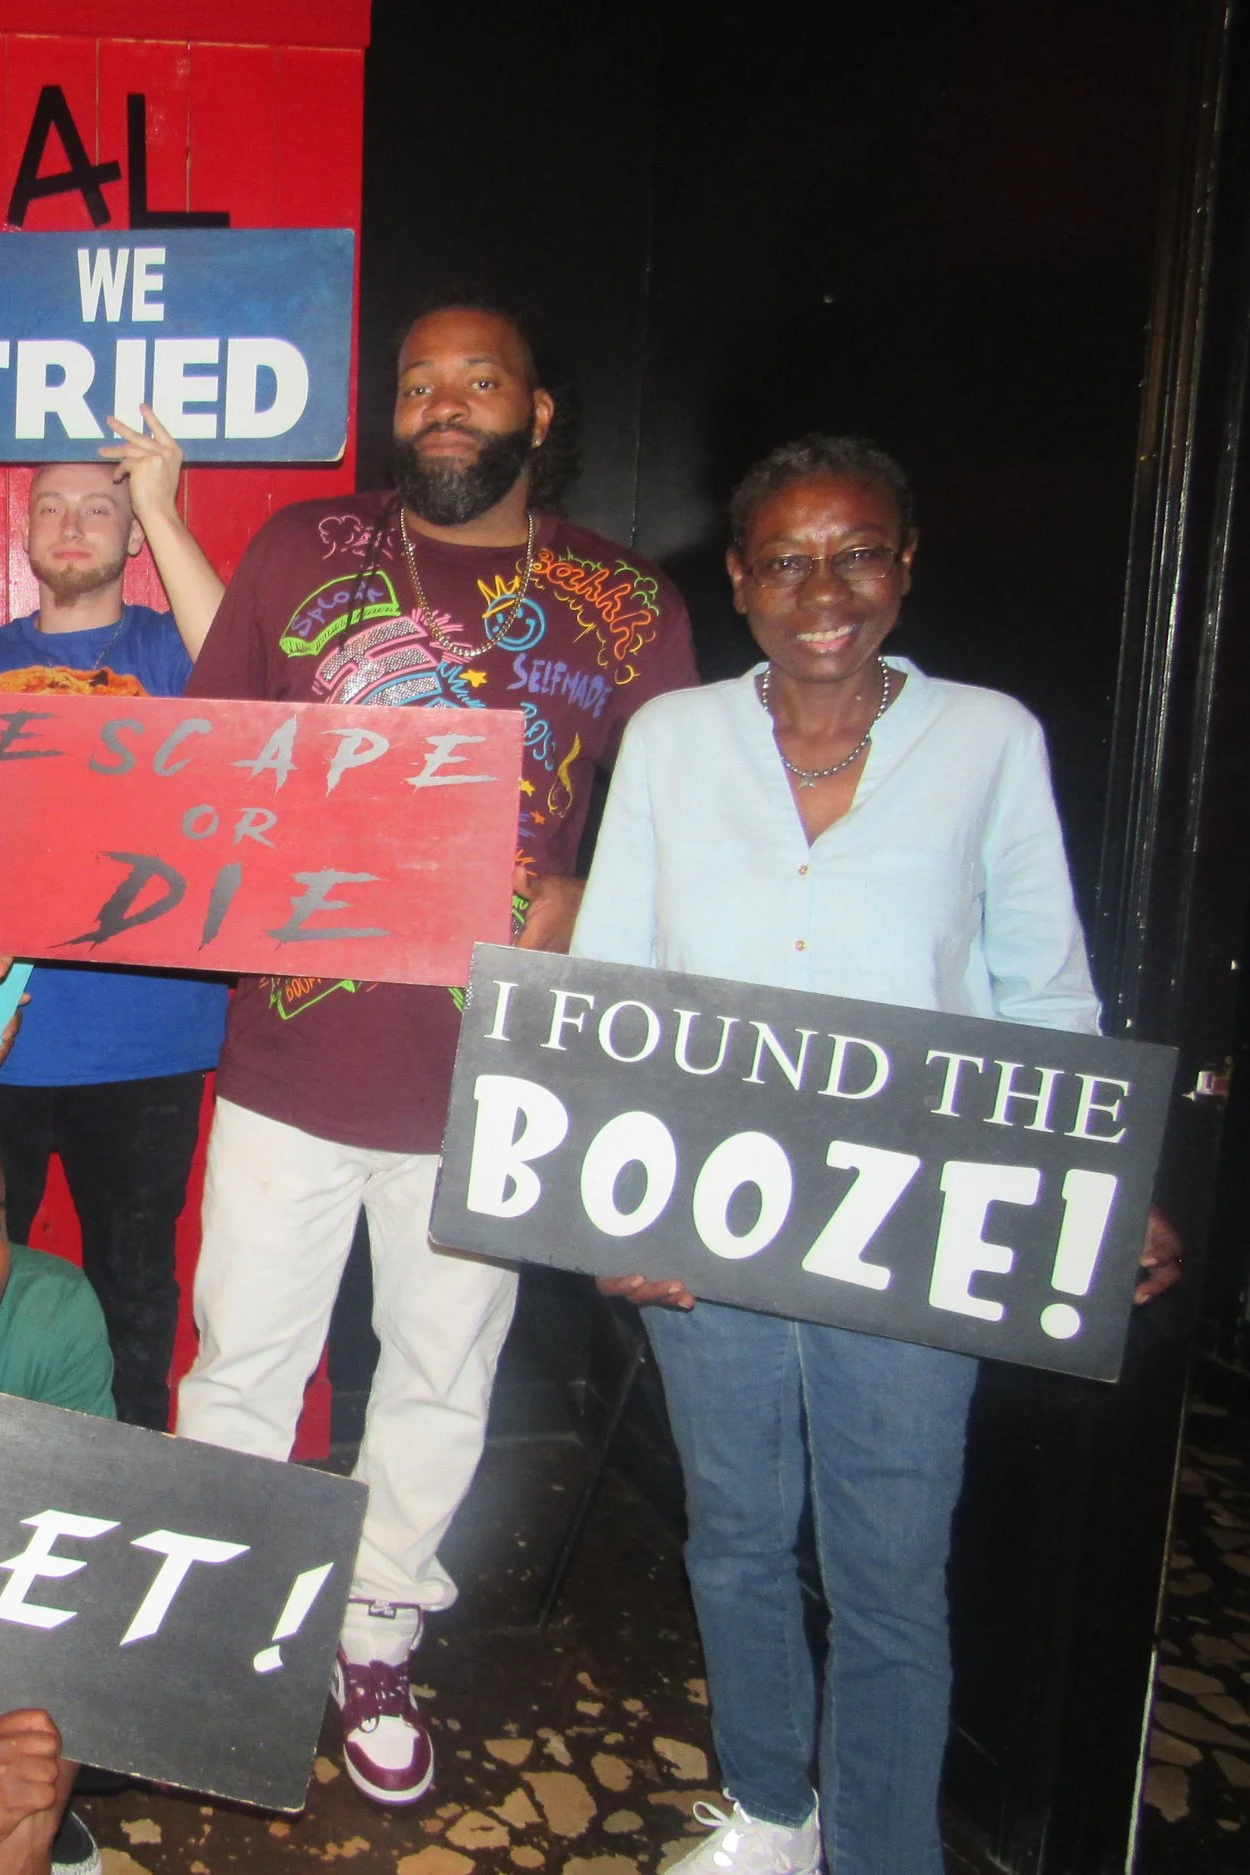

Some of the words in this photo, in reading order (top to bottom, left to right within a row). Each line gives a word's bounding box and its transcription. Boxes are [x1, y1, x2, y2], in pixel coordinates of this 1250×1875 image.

[77, 246, 167, 323] WE
[181, 804, 277, 848] OR
[47, 850, 393, 952] DIE
[484, 980, 519, 1042] I
[540, 988, 891, 1101] FOUND
[924, 1049, 1134, 1144] THE
[466, 1073, 1119, 1340] BOOZE!
